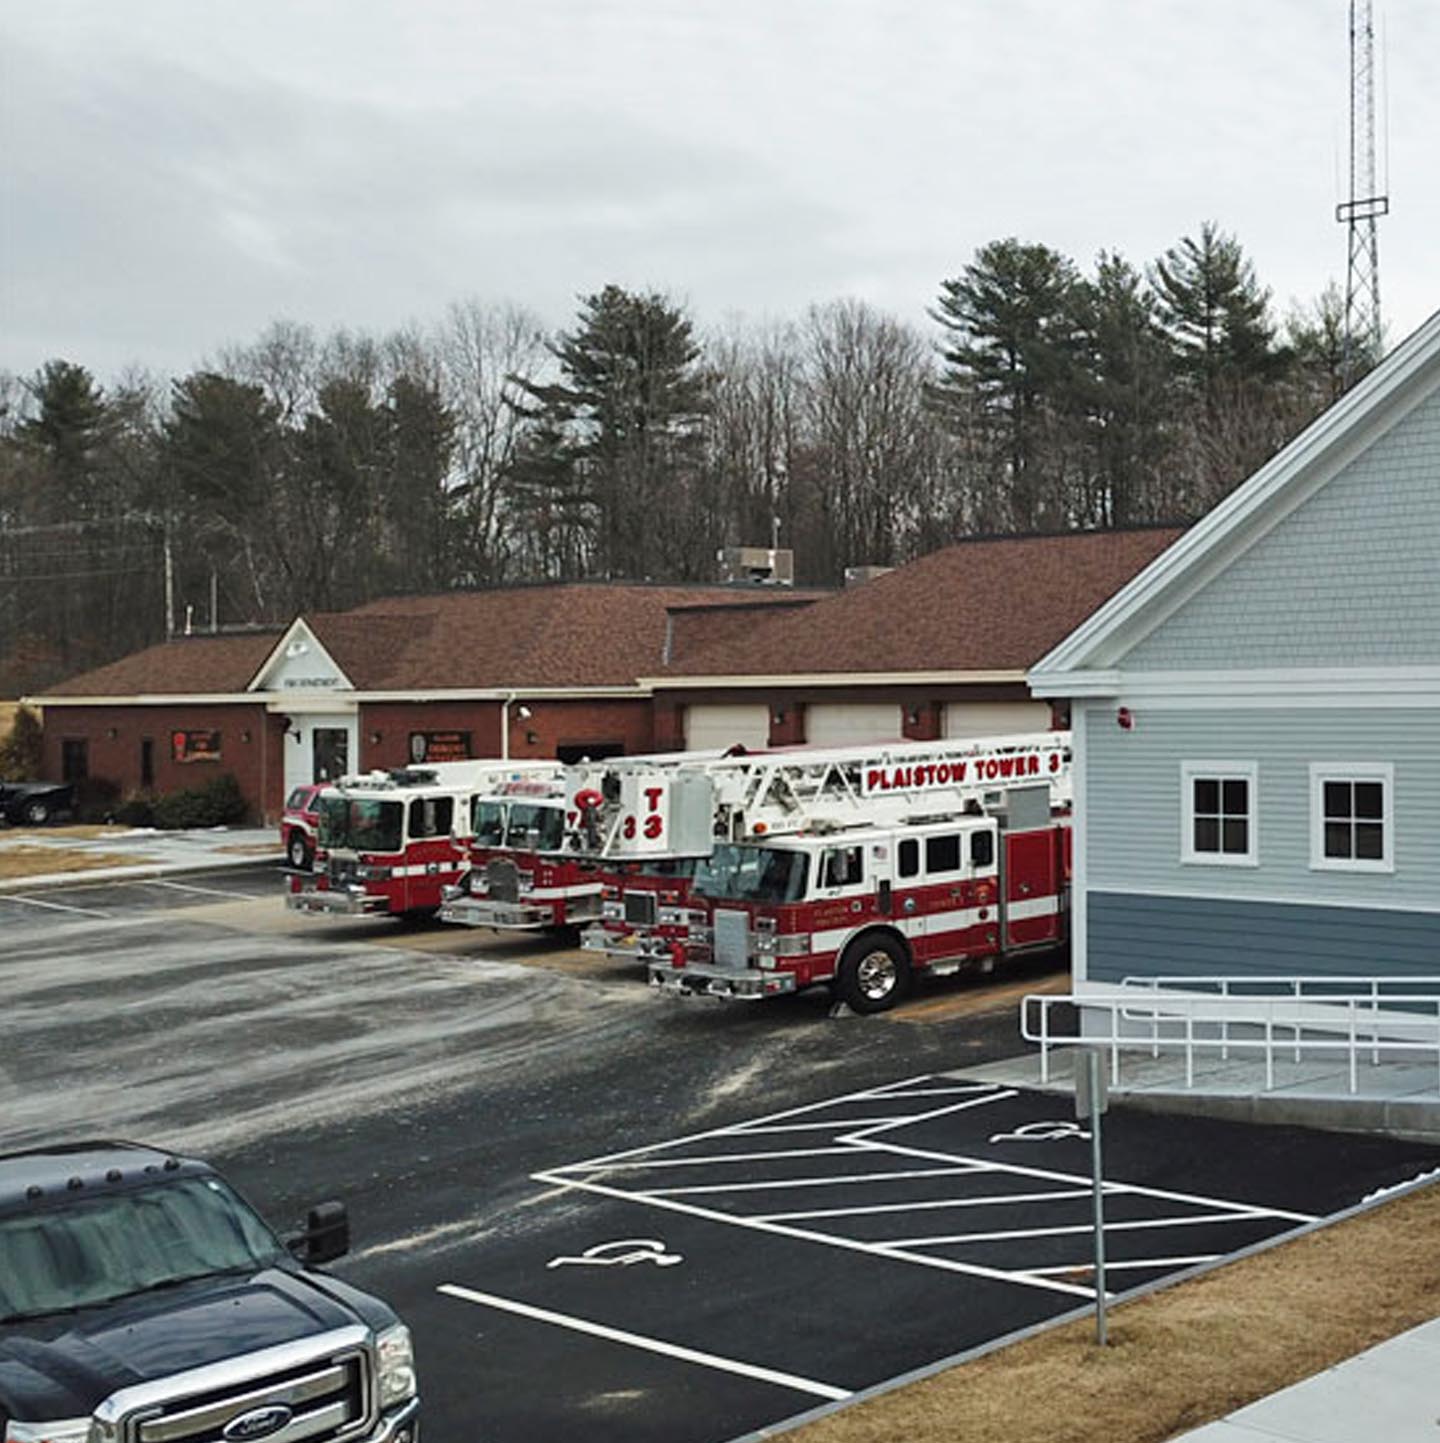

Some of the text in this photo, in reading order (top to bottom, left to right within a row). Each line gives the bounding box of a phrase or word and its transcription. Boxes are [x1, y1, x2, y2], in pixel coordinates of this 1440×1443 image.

[867, 753, 1060, 791] PLAISTOW TOWER 3
[643, 787, 664, 812] T
[643, 814, 663, 839] 3
